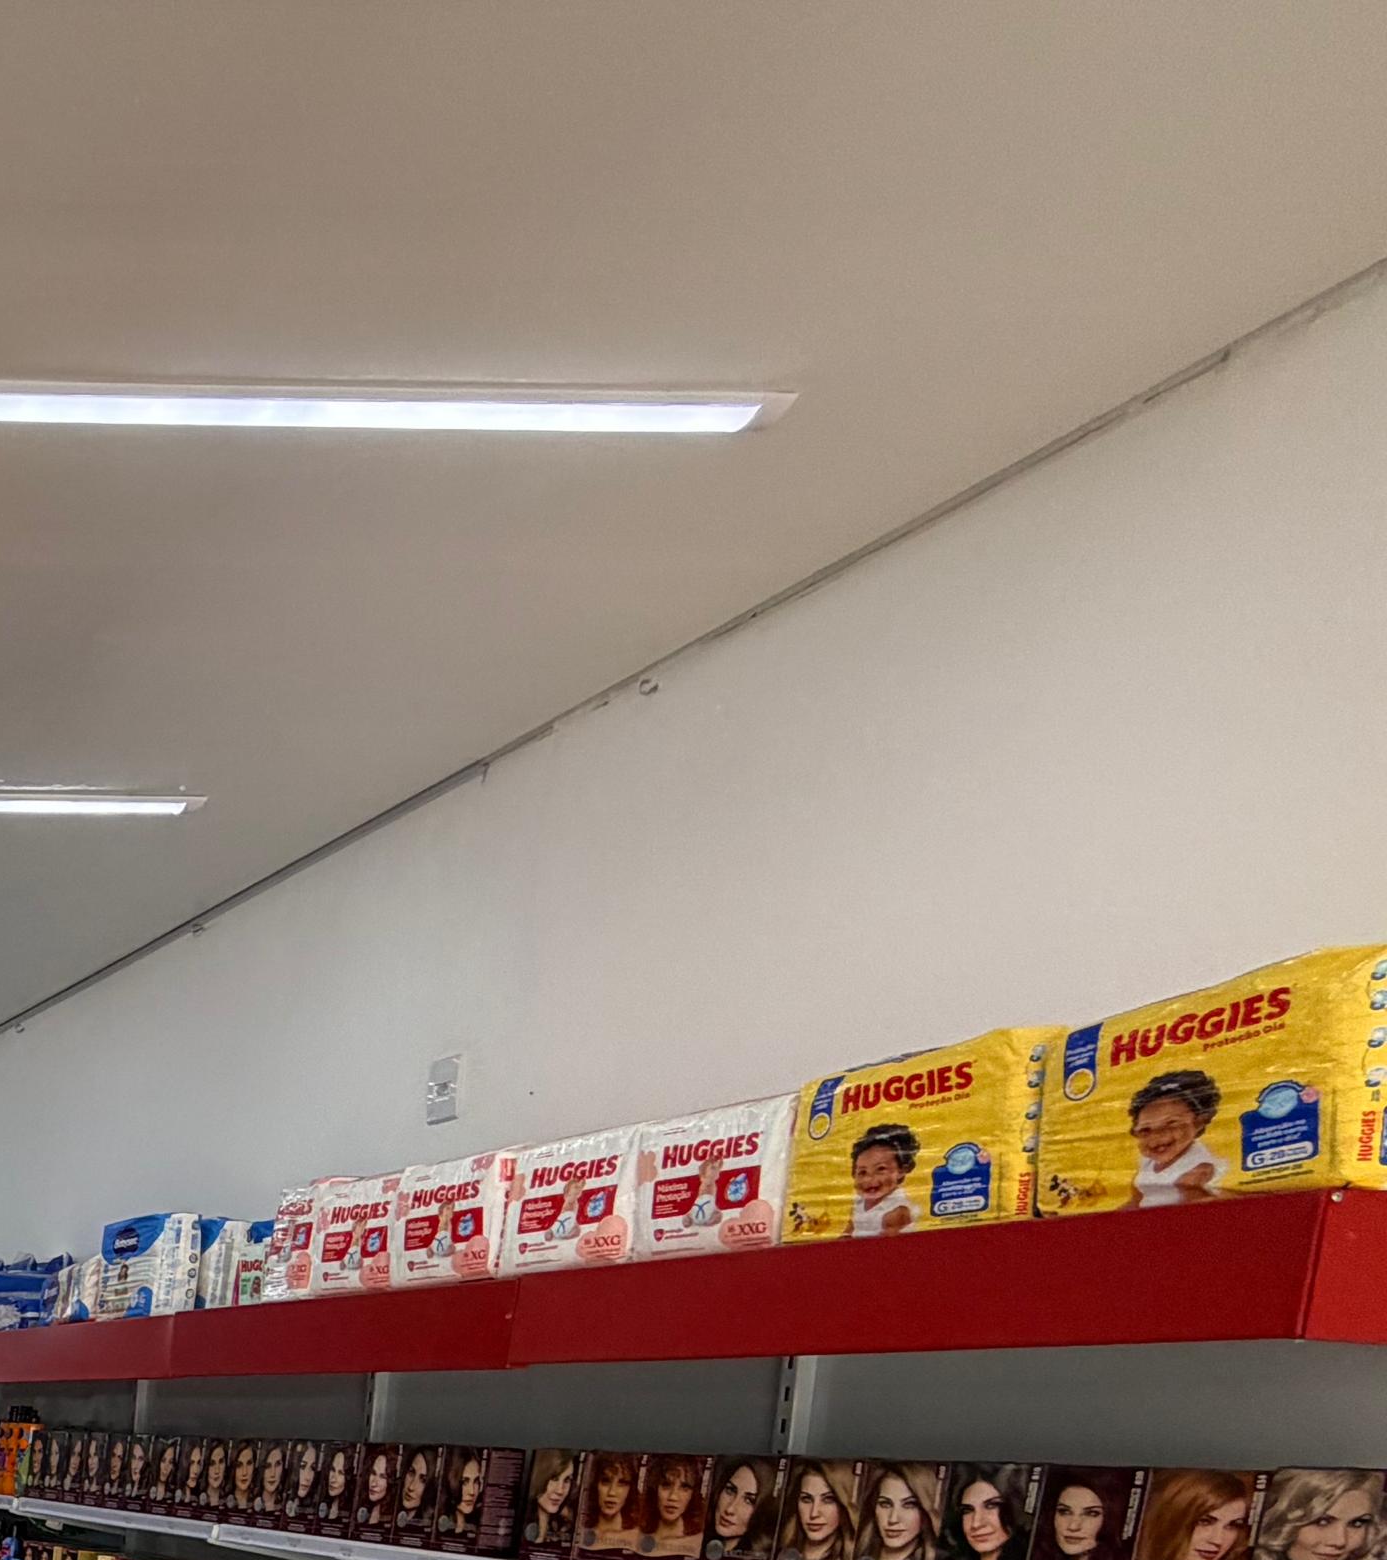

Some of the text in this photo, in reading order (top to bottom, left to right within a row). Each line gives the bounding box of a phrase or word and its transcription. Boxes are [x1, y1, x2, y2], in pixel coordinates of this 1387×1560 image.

[1110, 986, 1292, 1067] HUGGIES
[841, 1061, 974, 1115] HUGGIES
[661, 1132, 761, 1169] HUGGIES
[1357, 1110, 1377, 1162] HUGGIES
[530, 1155, 619, 1189] HUGGIES
[411, 1180, 481, 1210] HUGGIES
[330, 1201, 391, 1224] HUGGIES
[736, 1222, 767, 1235] XXG
[591, 1235, 621, 1248] XXG
